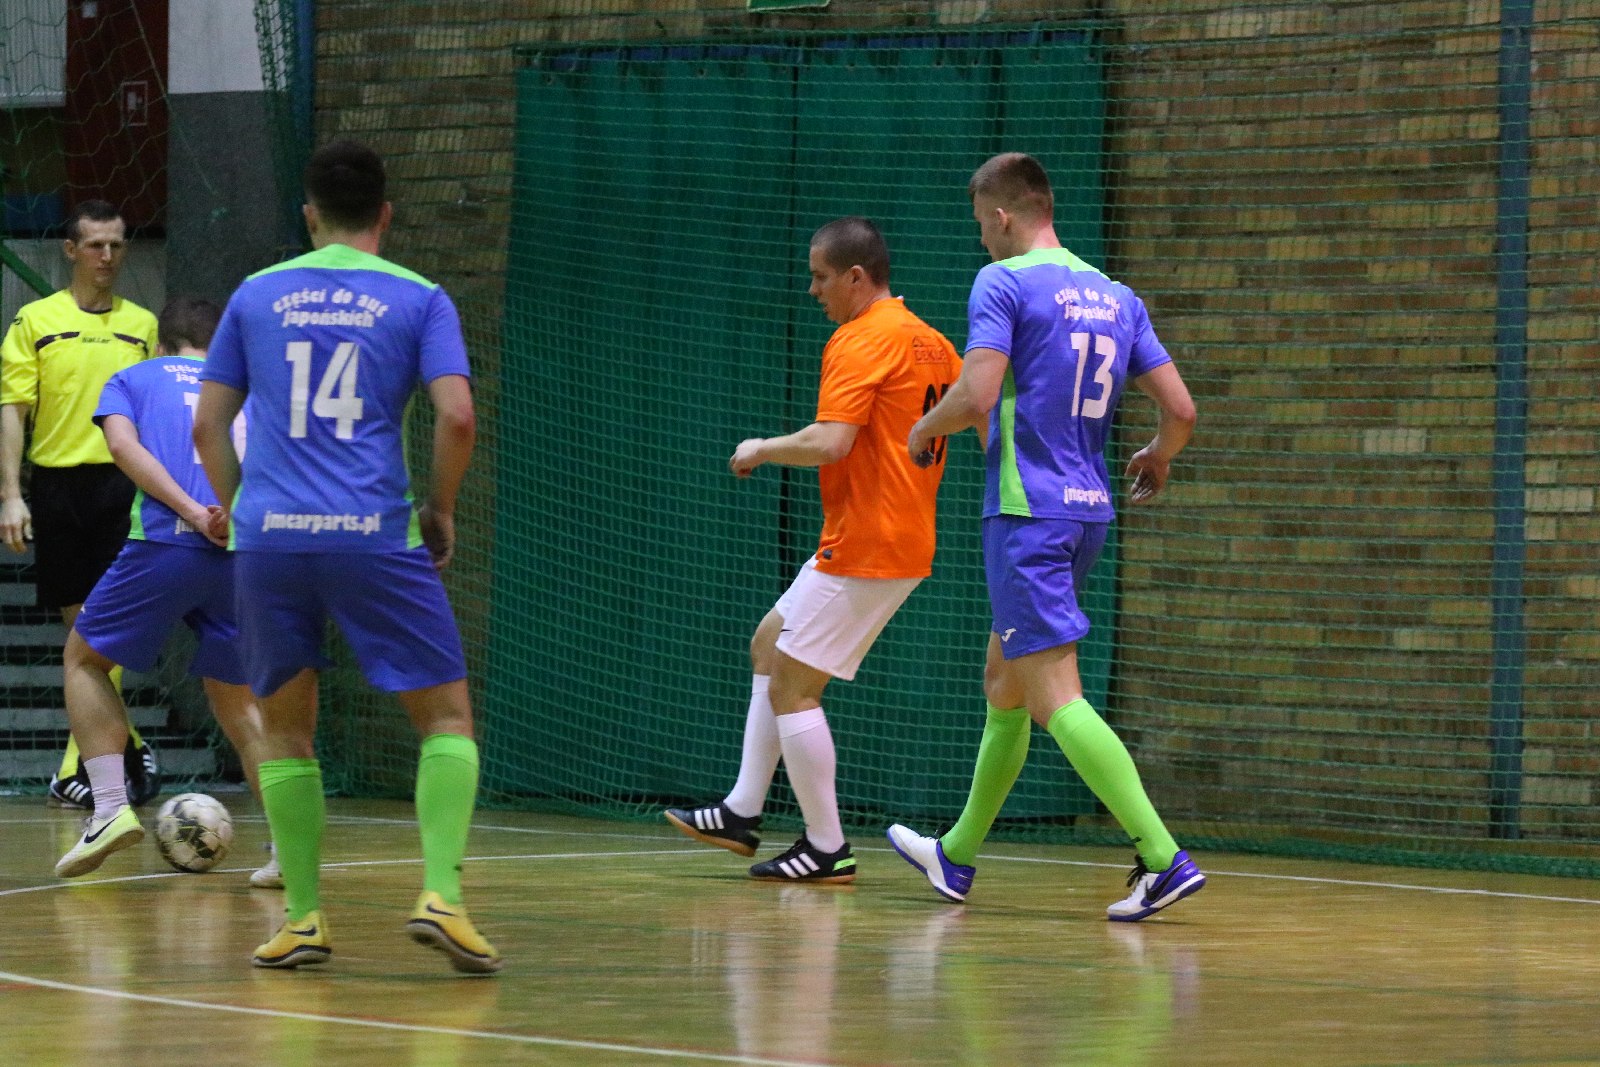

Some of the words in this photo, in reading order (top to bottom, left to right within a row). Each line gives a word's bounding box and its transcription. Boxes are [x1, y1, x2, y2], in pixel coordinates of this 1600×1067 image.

[331, 288, 353, 304] do
[1084, 287, 1100, 302] do
[1070, 331, 1117, 419] 13
[285, 341, 364, 439] 14
[262, 510, 381, 535] jmcarparts.pl
